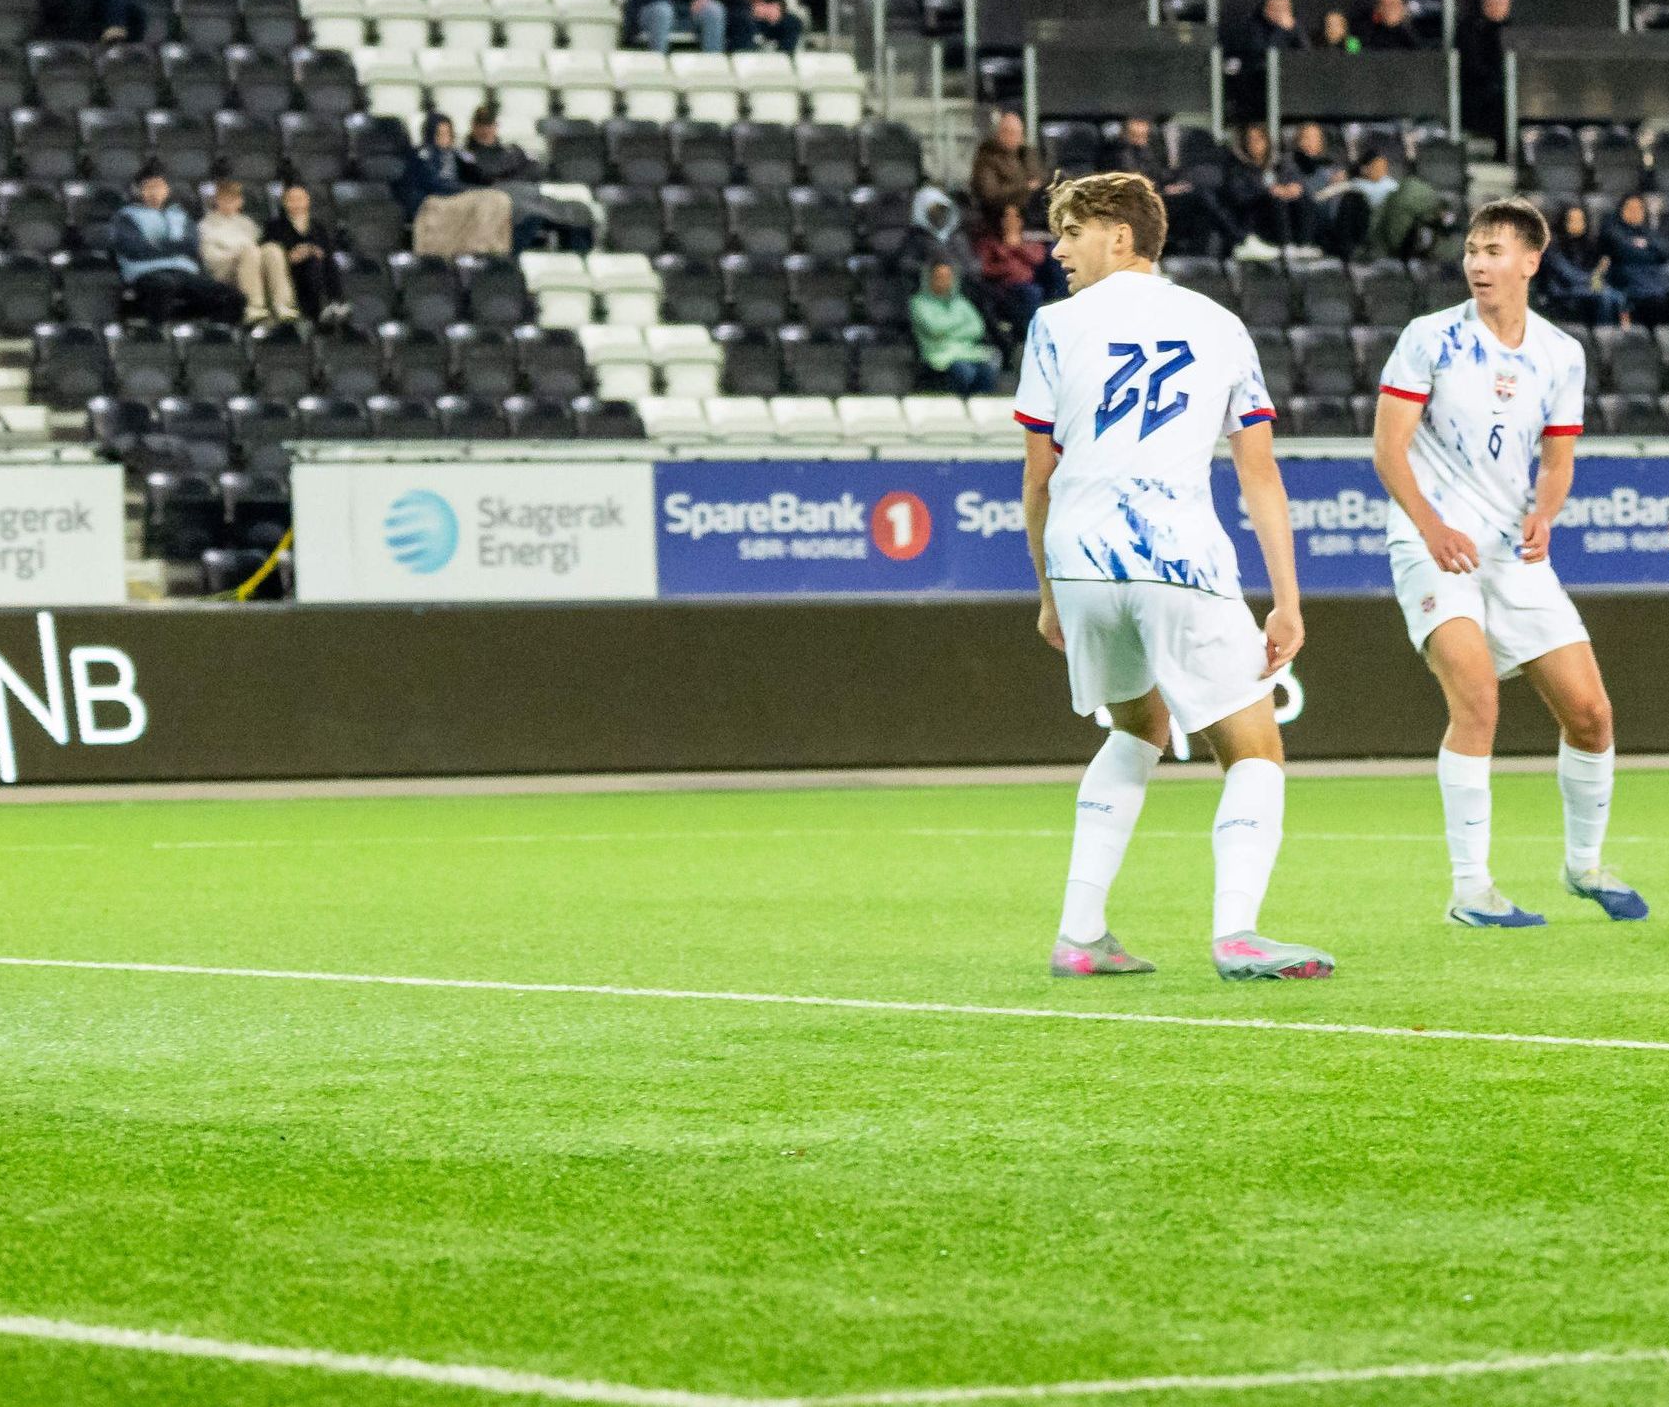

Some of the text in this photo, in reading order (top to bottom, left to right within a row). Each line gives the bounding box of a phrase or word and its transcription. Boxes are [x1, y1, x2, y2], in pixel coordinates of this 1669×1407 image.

[1094, 340, 1195, 442] 22
[1488, 424, 1504, 460] 6
[478, 495, 624, 535] Skagerak
[664, 491, 866, 540] SpareBank
[886, 501, 913, 548] 1
[479, 533, 581, 573] Energi
